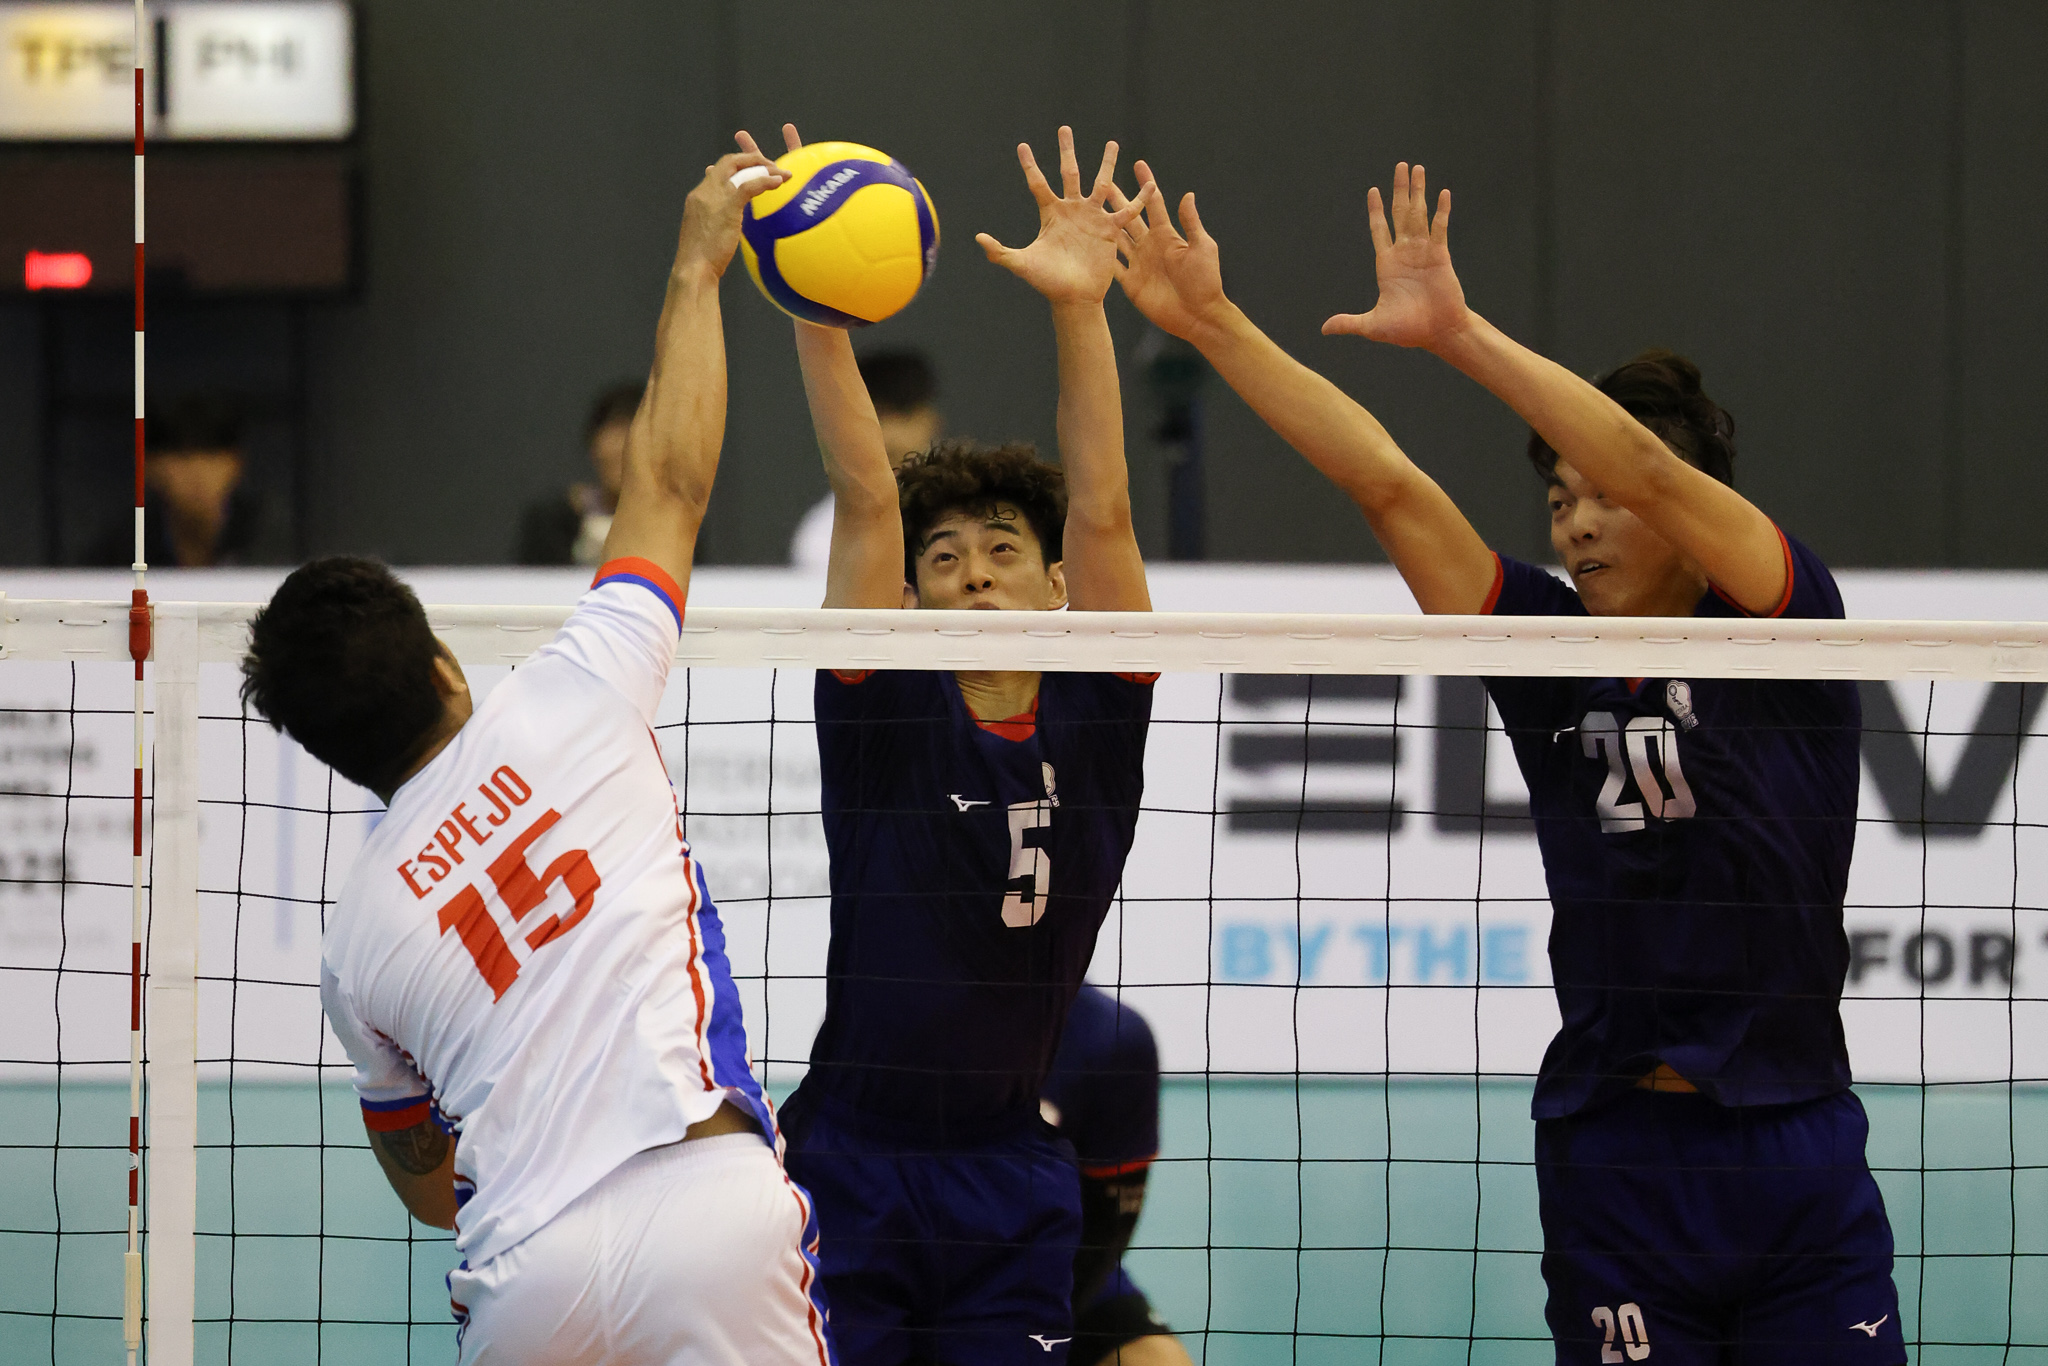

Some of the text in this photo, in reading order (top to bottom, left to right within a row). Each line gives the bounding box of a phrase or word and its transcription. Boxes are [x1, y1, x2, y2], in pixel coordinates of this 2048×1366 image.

[397, 765, 532, 900] ESPEJO
[1579, 711, 1697, 834] 20
[437, 807, 602, 1005] 15
[1000, 799, 1051, 928] 5
[1220, 921, 1332, 983] BY
[1352, 921, 1531, 984] THE
[1848, 928, 2020, 988] FOR
[1590, 1302, 1651, 1364] 20
